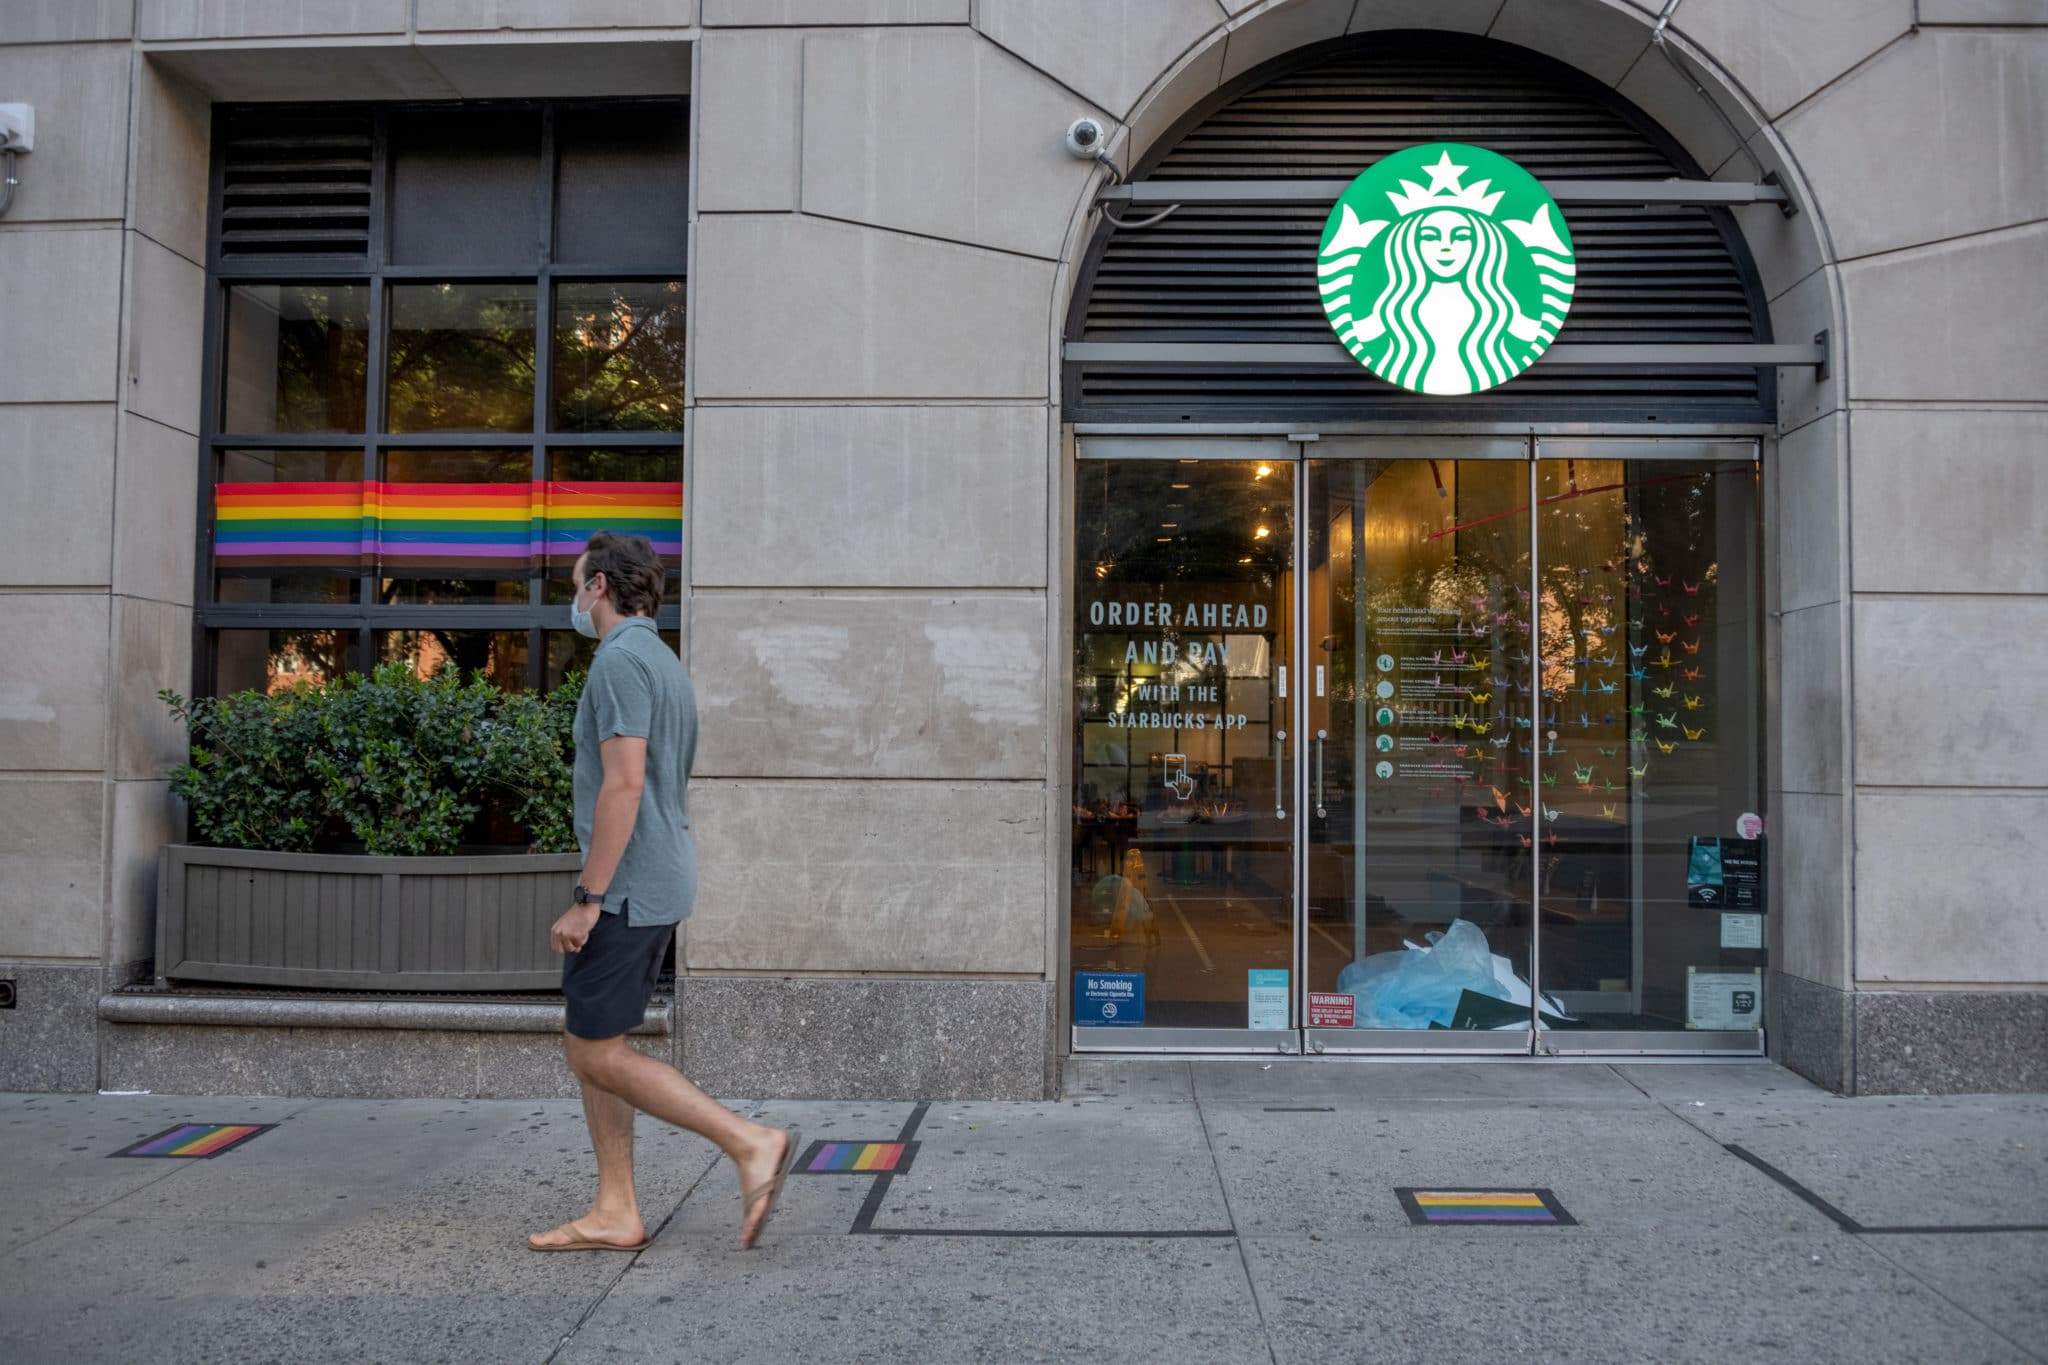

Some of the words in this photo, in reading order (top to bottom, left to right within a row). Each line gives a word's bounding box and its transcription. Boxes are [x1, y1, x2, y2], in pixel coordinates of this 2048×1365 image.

[1090, 601, 1172, 626] ORDER
[1184, 602, 1268, 628] AHEAD
[1125, 640, 1176, 665] AND
[1189, 641, 1231, 666] PAY
[1138, 685, 1180, 701] WITH
[1187, 686, 1218, 702] THE
[1214, 714, 1247, 730] APP
[1088, 979, 1098, 989] No
[1100, 979, 1132, 991] Smoking
[1311, 995, 1353, 1006] WARNING!
